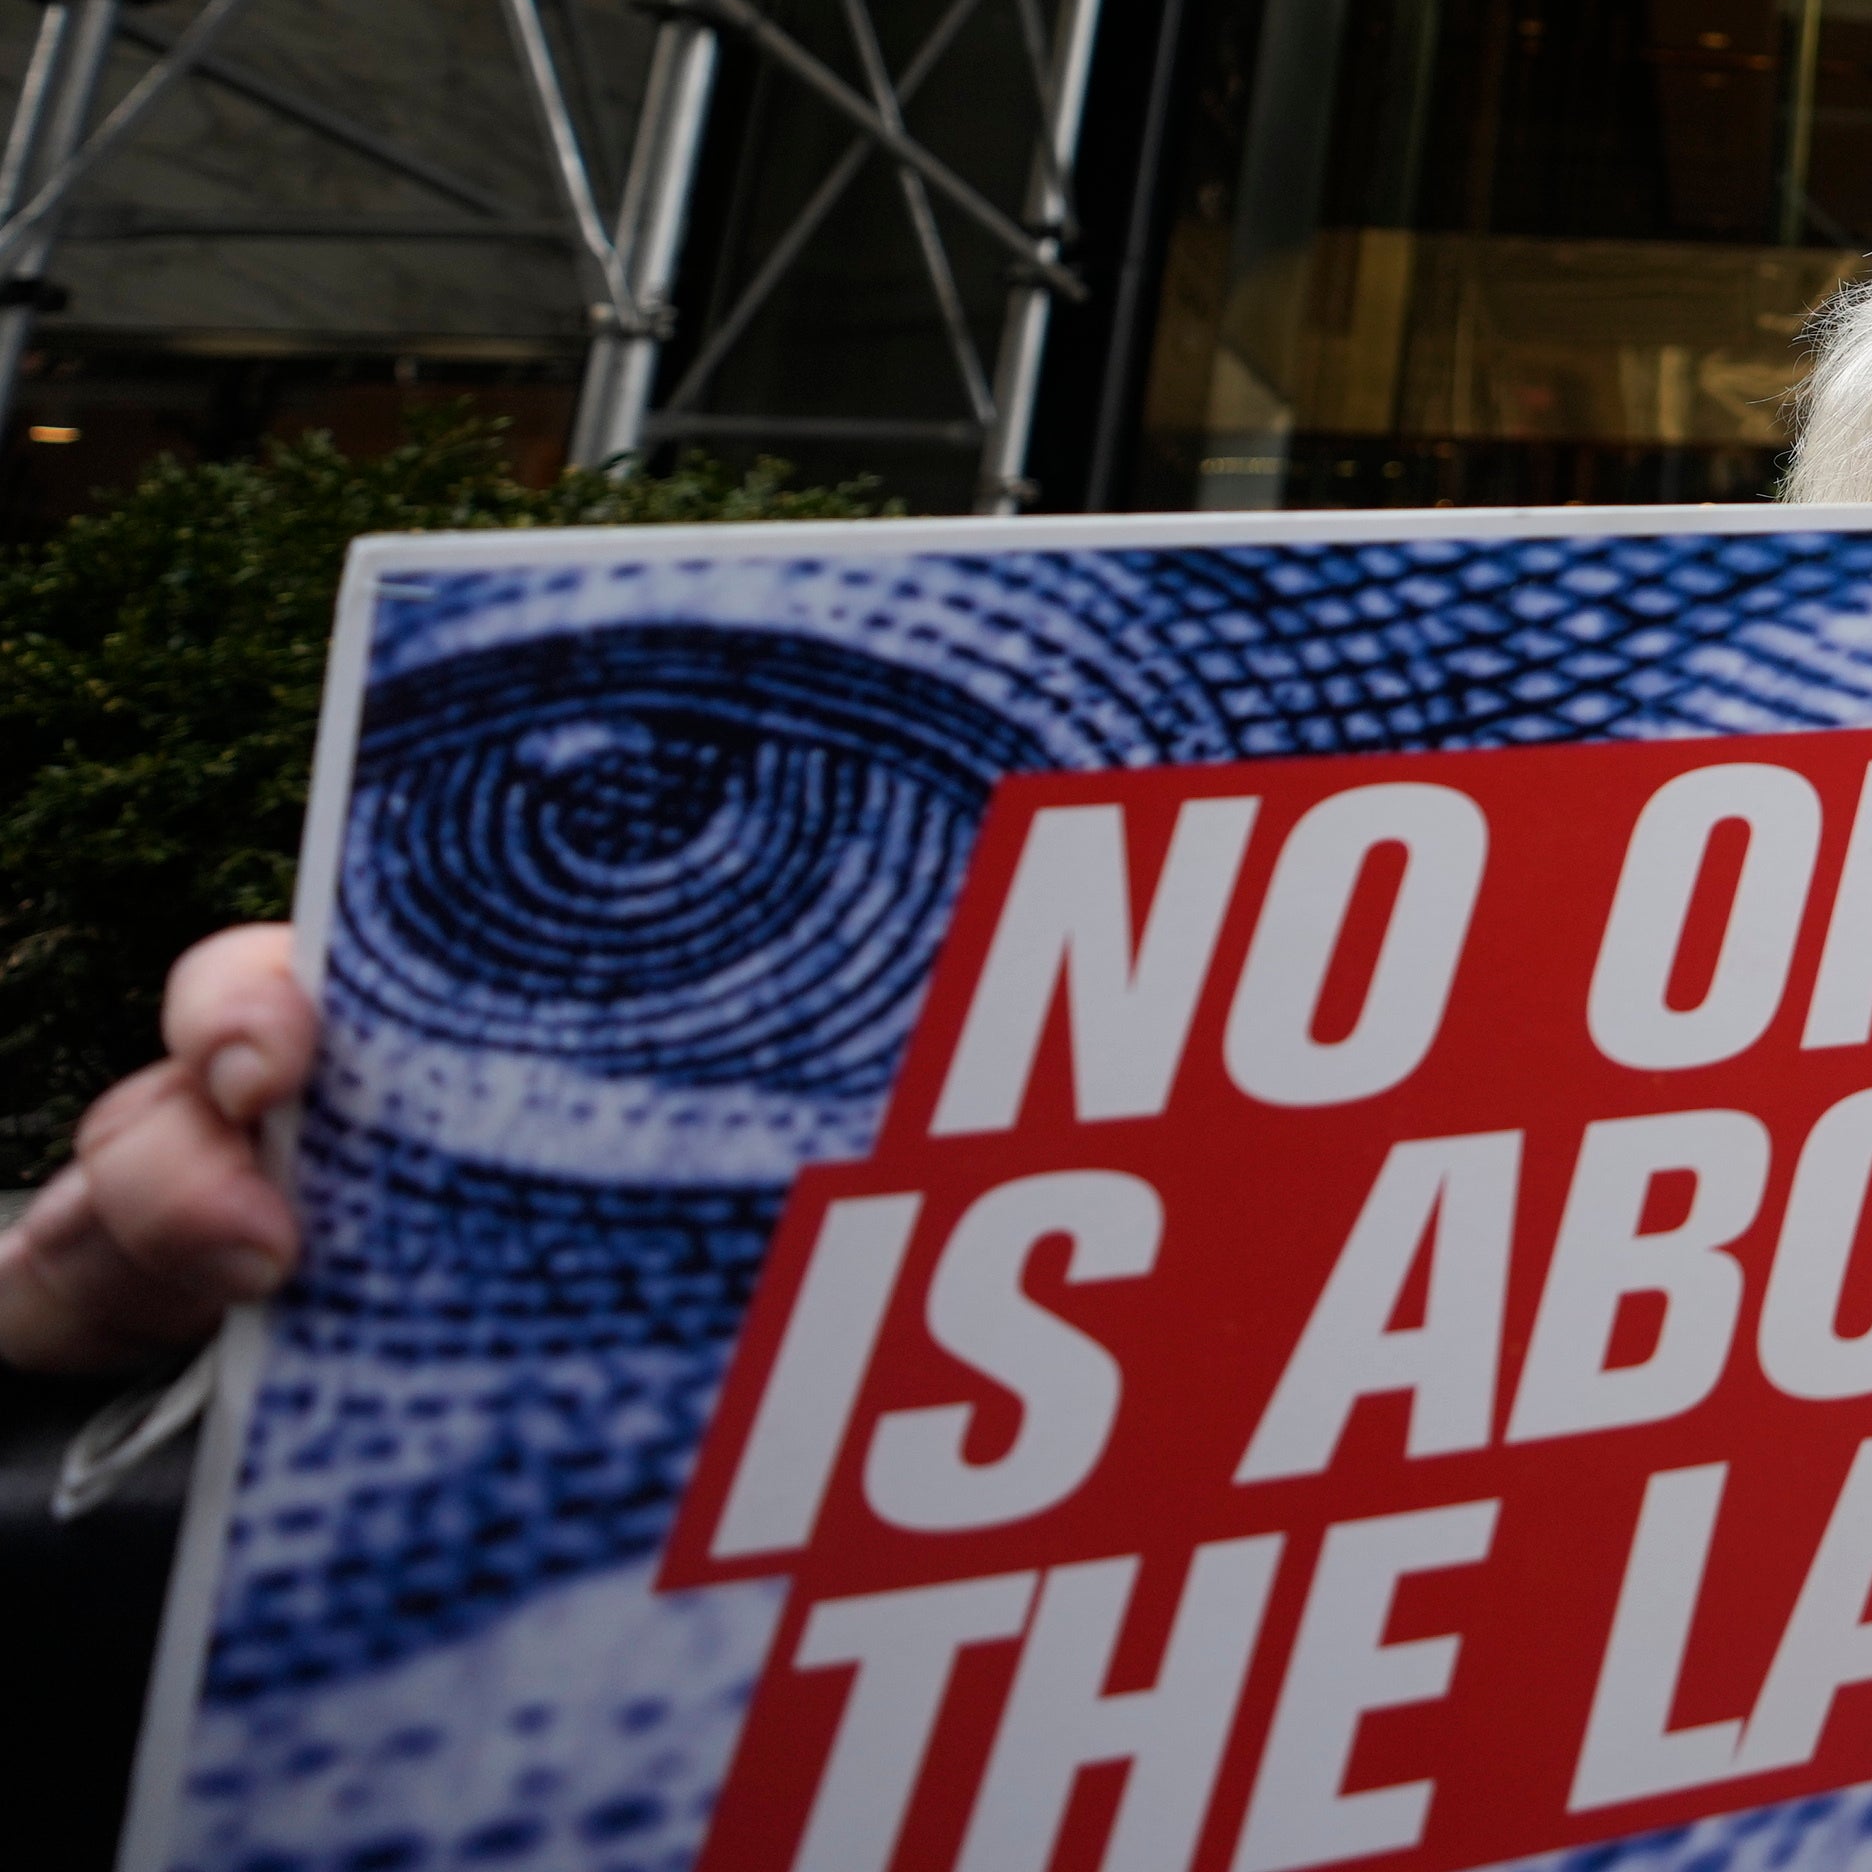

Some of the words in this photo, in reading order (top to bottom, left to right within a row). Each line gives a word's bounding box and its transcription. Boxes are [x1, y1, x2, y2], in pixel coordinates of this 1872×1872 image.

[928, 780, 1491, 1138] NO
[708, 1166, 1165, 1562] IS
[788, 1497, 1502, 1872] THE
